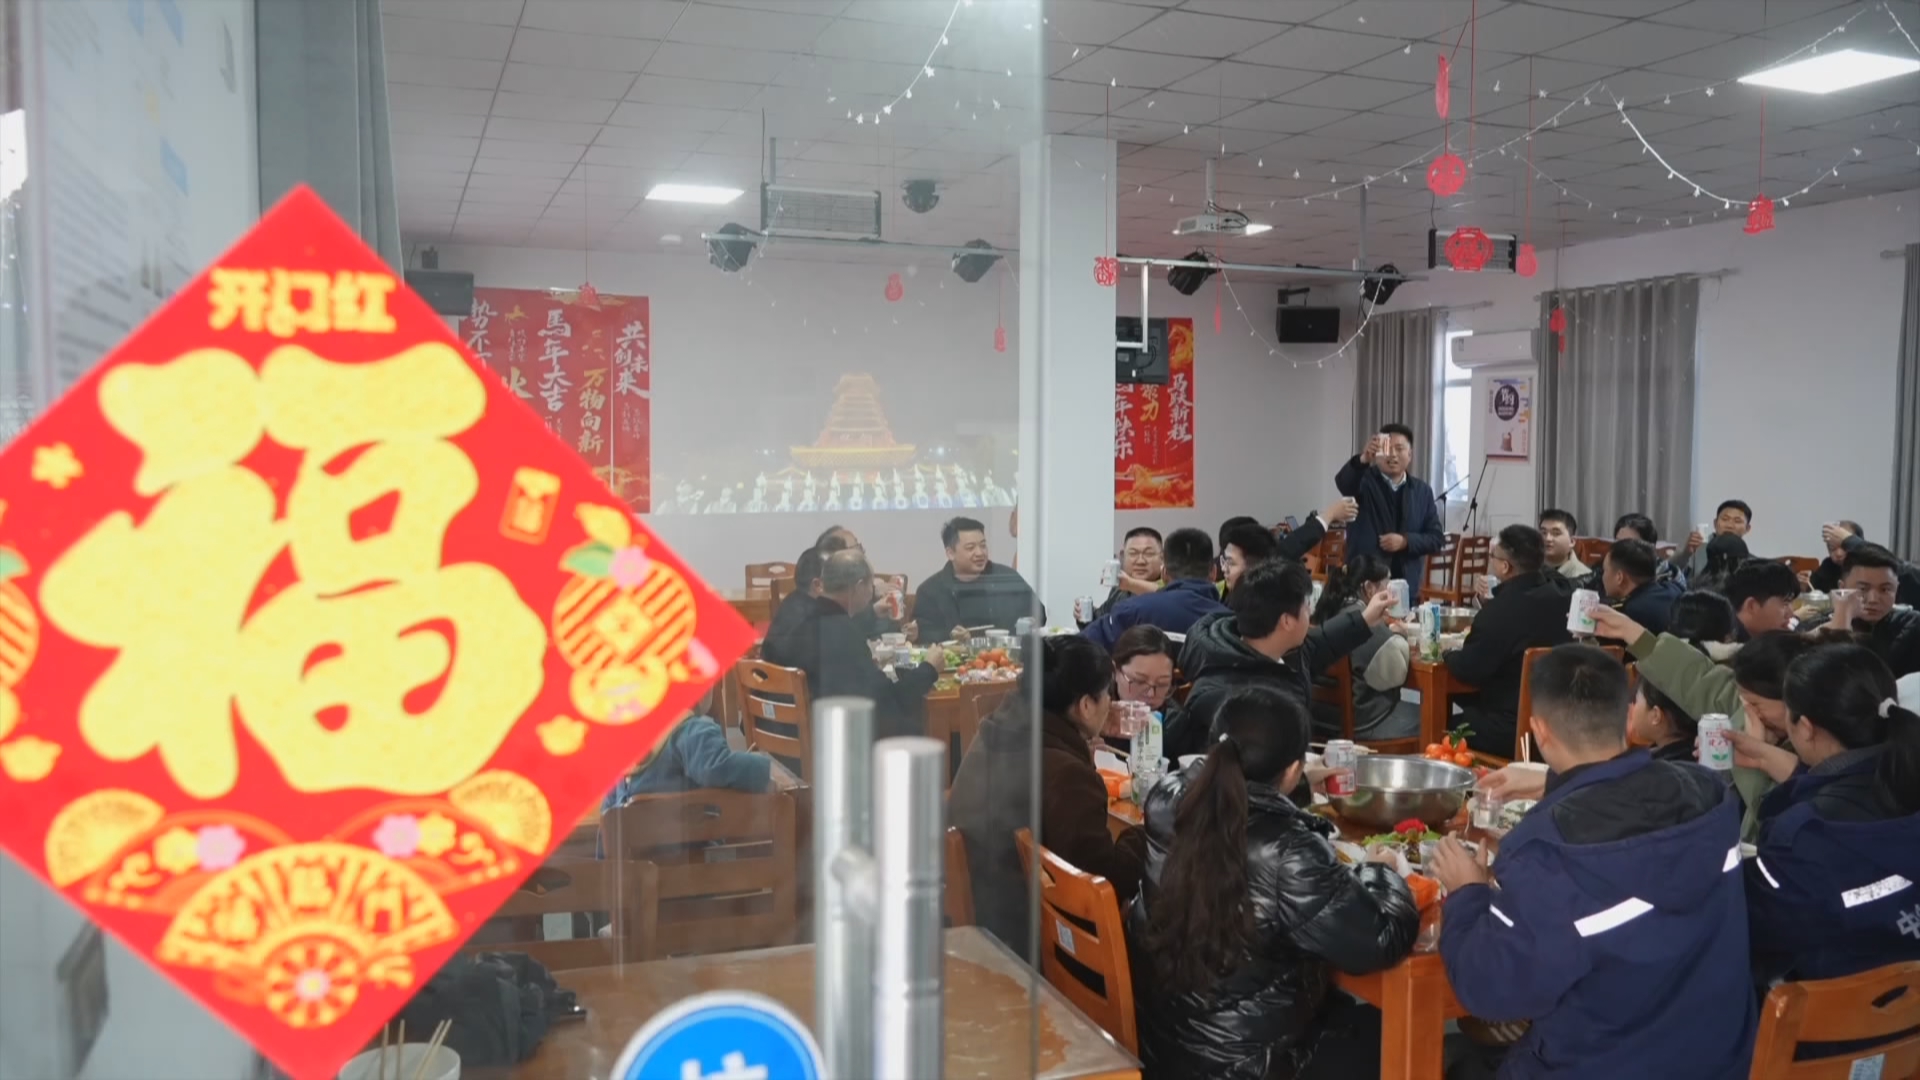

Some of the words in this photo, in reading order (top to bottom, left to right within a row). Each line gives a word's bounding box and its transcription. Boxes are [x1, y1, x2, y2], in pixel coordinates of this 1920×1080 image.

[207, 267, 397, 337] 开门红
[537, 308, 574, 412] 馬年大吉
[578, 367, 609, 456] 万物向新
[40, 342, 547, 799] 福
[1896, 904, 1920, 940] 中
